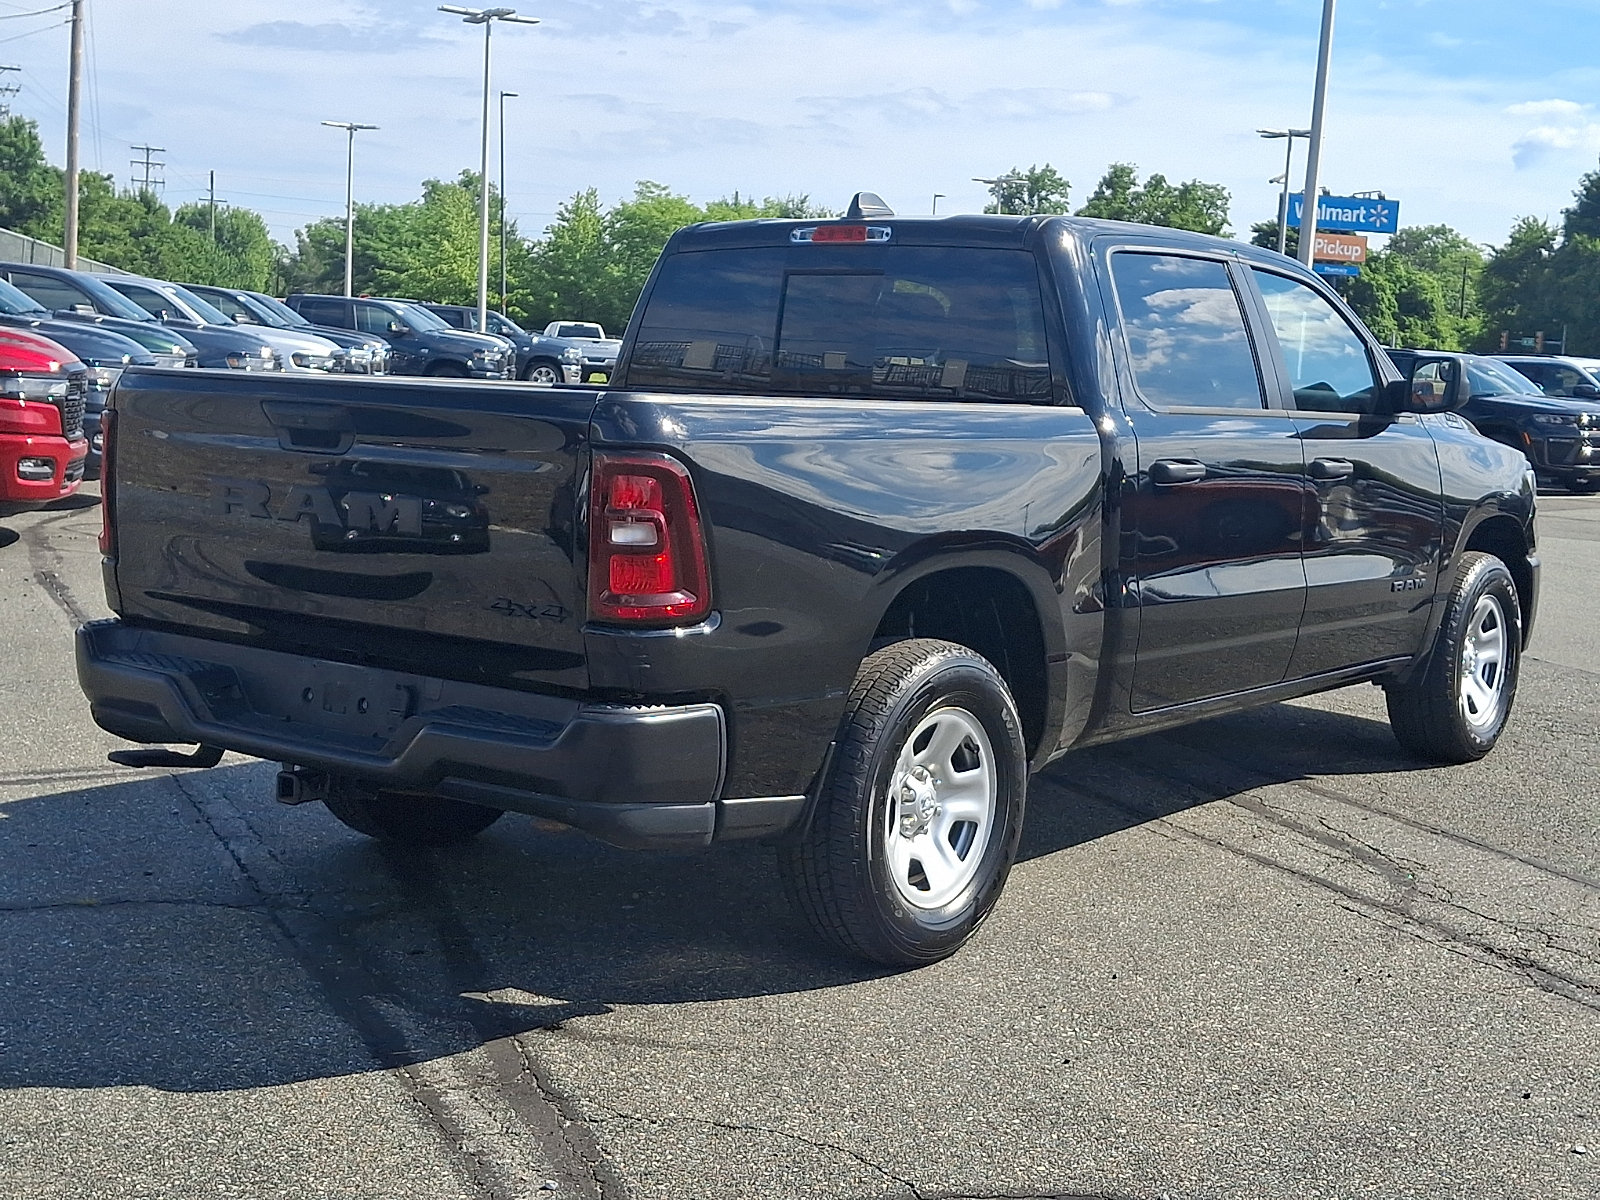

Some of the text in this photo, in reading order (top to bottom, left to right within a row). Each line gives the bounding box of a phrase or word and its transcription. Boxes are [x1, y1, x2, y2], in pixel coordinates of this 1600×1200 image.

[1315, 239, 1361, 260] Pickup
[211, 476, 422, 537] RAM
[1391, 577, 1427, 592] RAM
